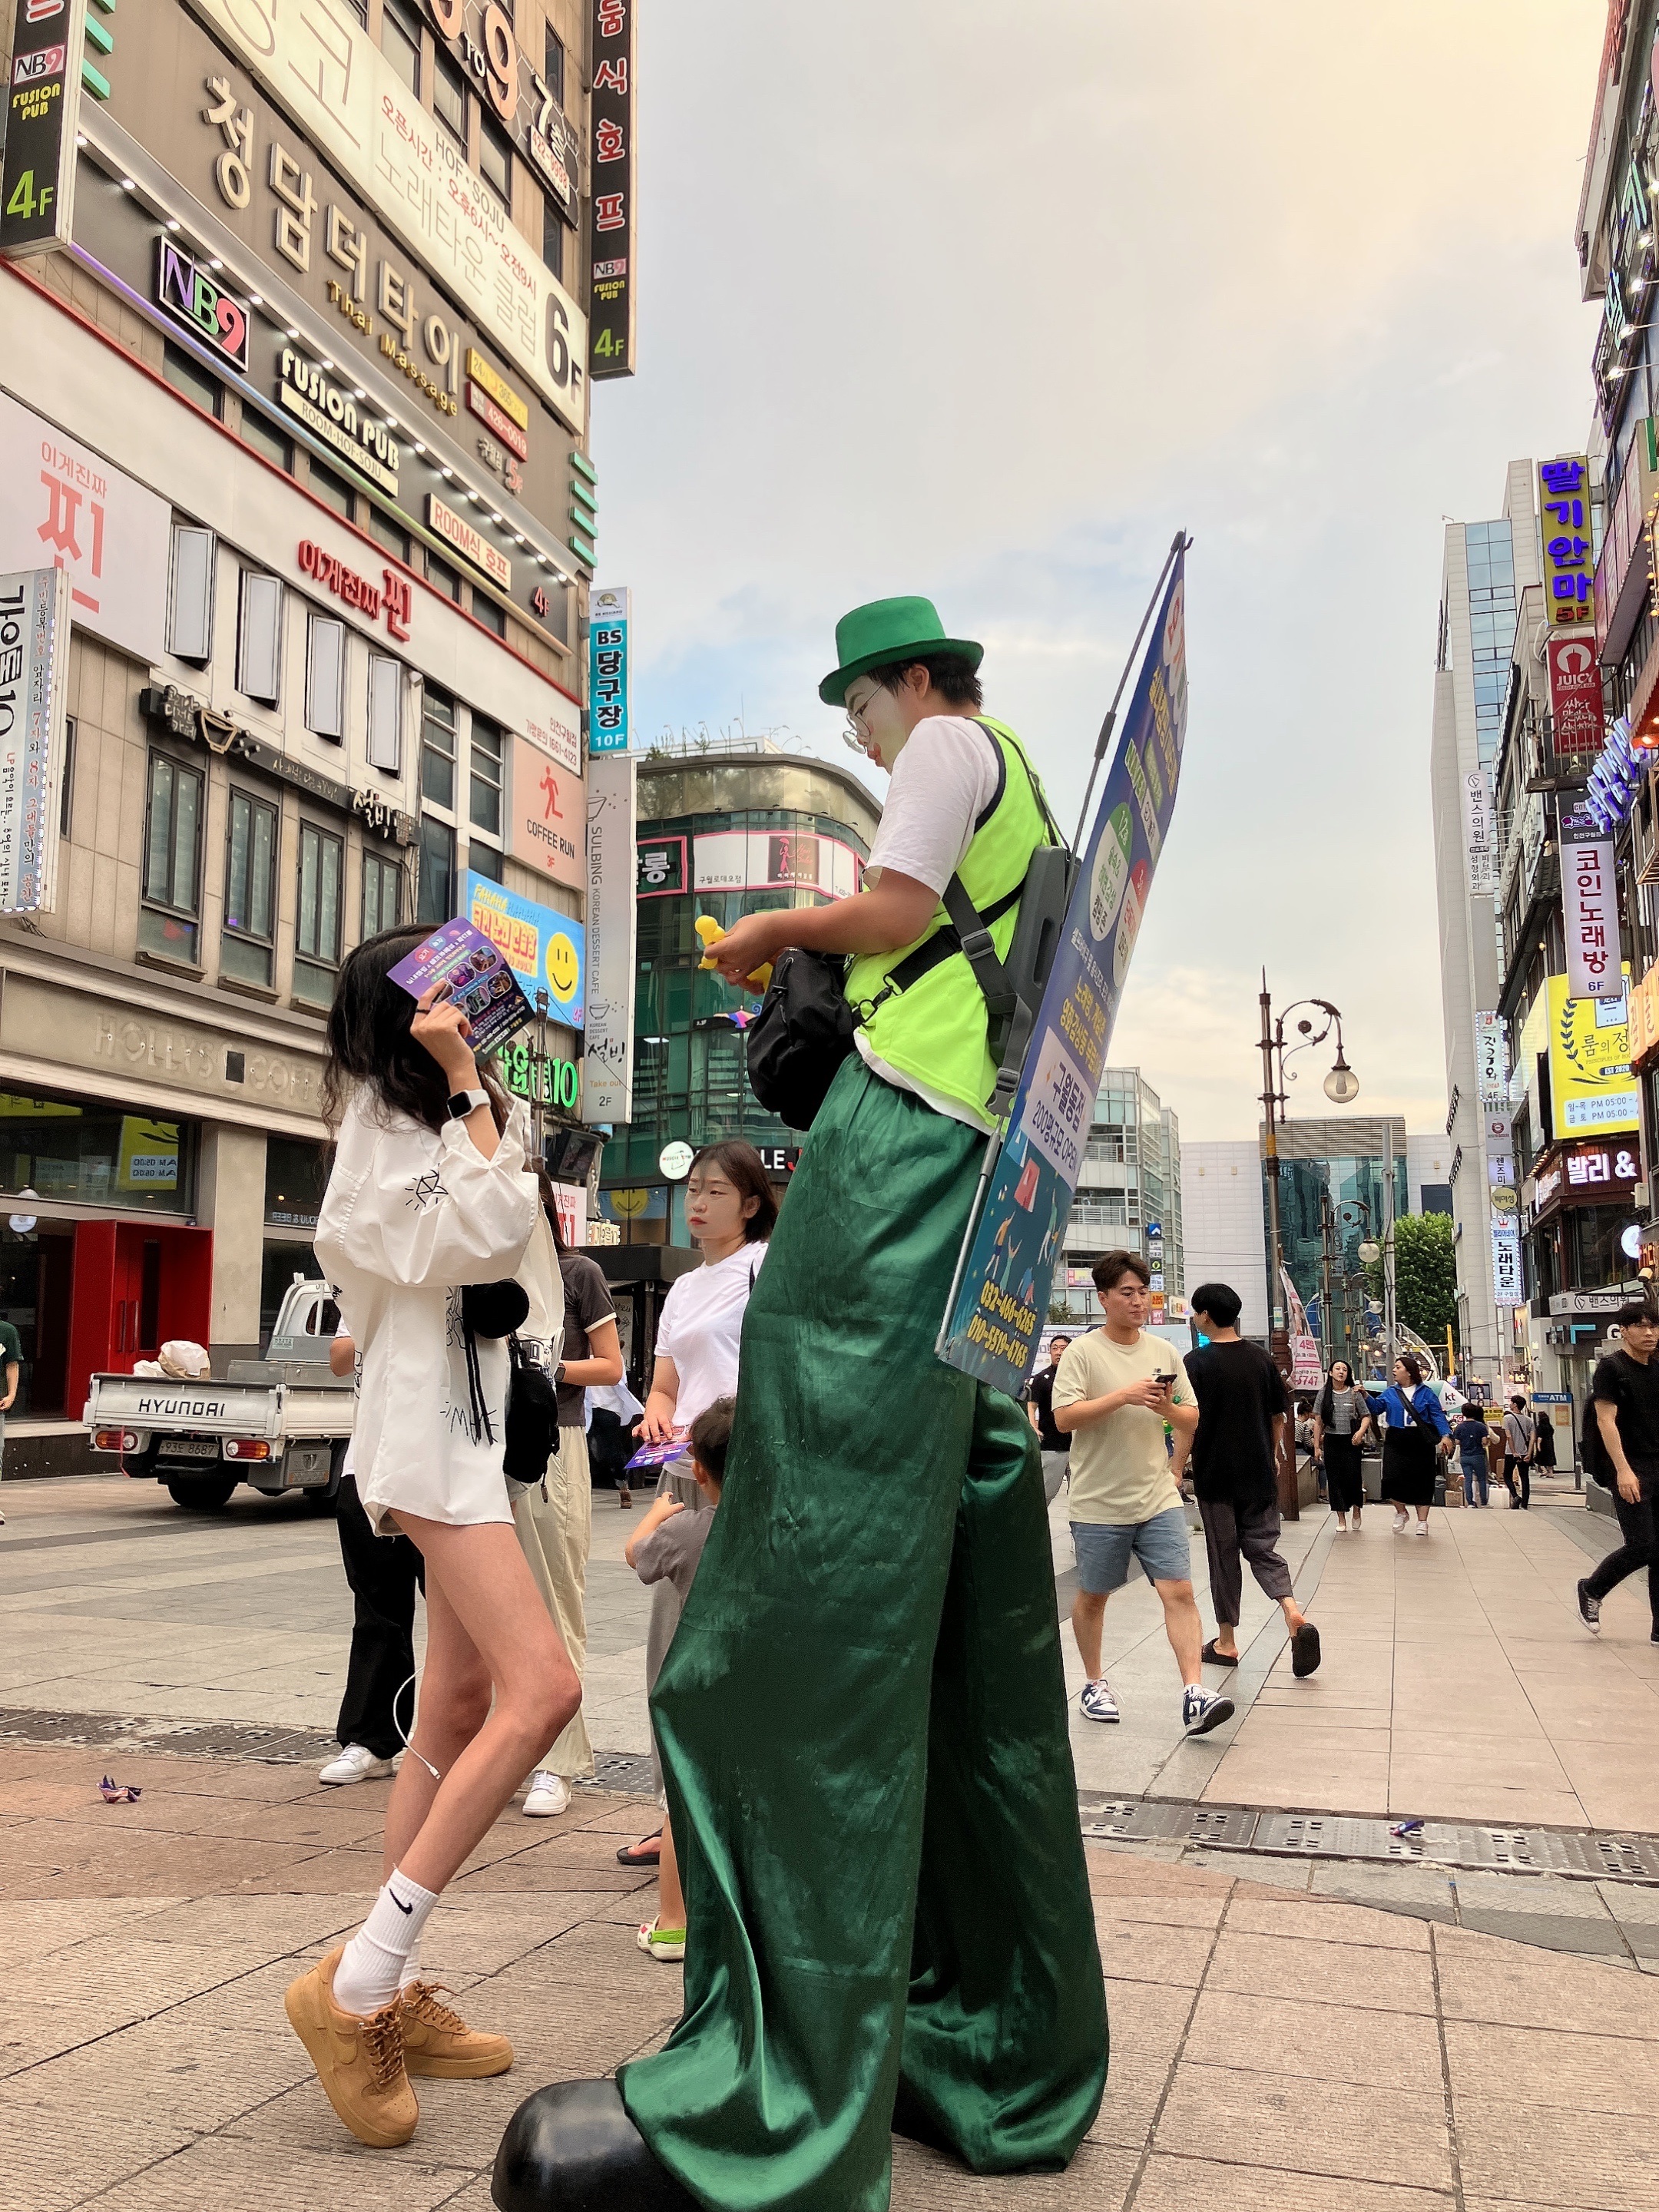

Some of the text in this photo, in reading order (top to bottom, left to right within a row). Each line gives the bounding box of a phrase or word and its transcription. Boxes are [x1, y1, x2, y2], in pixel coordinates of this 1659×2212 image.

[15, 52, 64, 77] NB9
[12, 83, 61, 109] FUSION
[22, 101, 49, 121] PUB
[6, 170, 54, 219] 4F
[381, 95, 433, 172] 오픈시간
[499, 243, 537, 301] 오전9시
[375, 132, 488, 296] 노래타운
[201, 76, 461, 397] 청담더타이
[595, 259, 626, 278] NB9
[165, 246, 246, 355] NB9
[594, 281, 625, 293] FUSION
[601, 290, 618, 300] PUB
[327, 279, 459, 418] Thai Massage
[594, 328, 624, 358] 4F
[280, 348, 400, 472] FUSION PUB
[41, 440, 108, 500] 이게진짜
[1541, 460, 1594, 603] 딸기안마
[485, 546, 508, 583] 호프
[297, 539, 381, 623] 이게진짜
[533, 585, 551, 620] 4F
[1555, 605, 1590, 623] 5F
[597, 629, 623, 646] BS
[595, 650, 624, 730] 당구장
[1557, 673, 1594, 687] JUICY
[548, 736, 578, 767] 1661-4123
[594, 733, 625, 748] 10F
[526, 819, 575, 860] COFFEE RUN
[699, 875, 742, 884] 구월로데오점
[591, 826, 603, 995] SULBING KOREAN DESSERT CAFE
[1575, 849, 1609, 975] 코인노래방
[1588, 980, 1604, 992] 6F
[588, 1038, 626, 1064] 설빙
[589, 1080, 607, 1088] Take
[1052, 1061, 1086, 1134] 구월동점
[598, 1095, 612, 1107] 2F
[1591, 1099, 1604, 1109] PM
[1604, 1097, 1628, 1107] 05:00
[1591, 1111, 1604, 1121] PM
[1605, 1108, 1628, 1118] 05:00
[1567, 1152, 1611, 1185] 발리
[1497, 1241, 1515, 1288] 노래타운
[138, 1399, 226, 1418] HYUNDAI
[1445, 1392, 1456, 1402] kt
